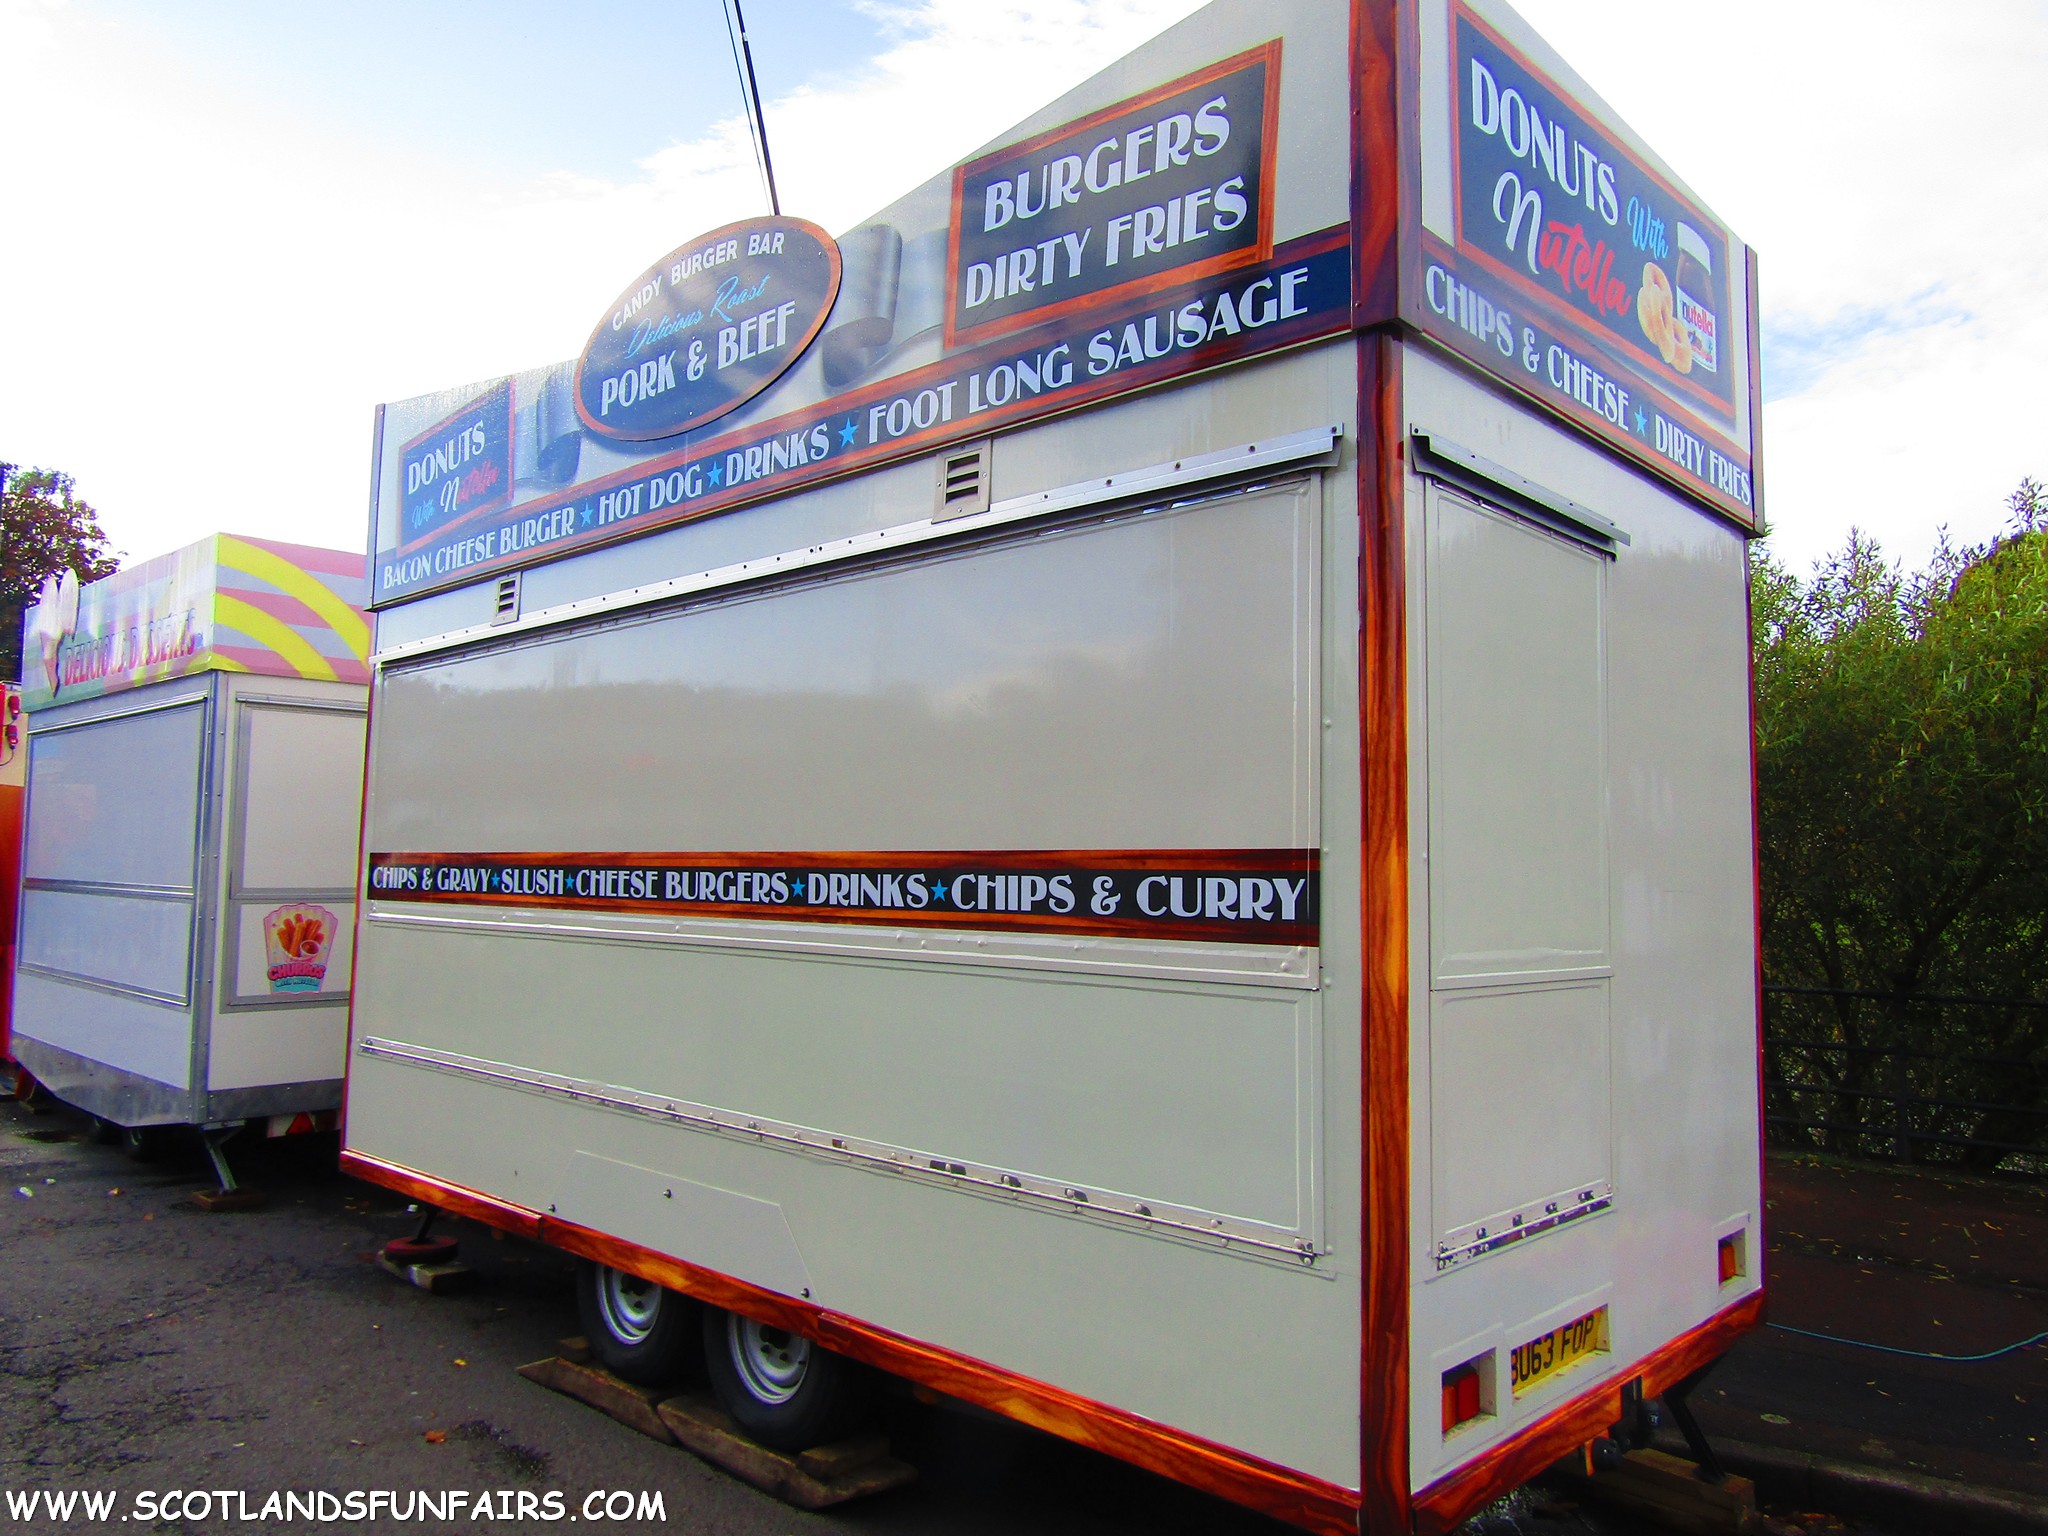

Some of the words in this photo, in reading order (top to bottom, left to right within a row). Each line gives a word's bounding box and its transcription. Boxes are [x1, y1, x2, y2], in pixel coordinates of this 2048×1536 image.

[983, 95, 1231, 233] BURGERS
[1471, 57, 1619, 226] DONUTS
[1626, 195, 1669, 259] With
[612, 275, 663, 331] CANDY
[671, 239, 738, 287] BURGER
[747, 231, 785, 256] BAR
[964, 226, 1092, 309] DIRTY
[1105, 175, 1248, 267] FRIES
[1492, 171, 1632, 317] Nutella
[601, 350, 676, 417] PORK
[686, 340, 708, 382] &
[717, 300, 796, 370] BEEF
[624, 307, 704, 360] Delicious
[710, 273, 770, 323] Roast
[383, 550, 431, 590] BACON
[434, 533, 495, 573] CHEESE
[499, 507, 574, 556] BURGER
[599, 489, 641, 525] HOT
[650, 467, 702, 510] DOG
[725, 423, 830, 487] DRINKS
[868, 380, 958, 445] FOOT
[969, 343, 1074, 414] LONG
[1087, 266, 1309, 377] SAUSAGE
[1425, 264, 1514, 361] CHIPS
[1522, 327, 1541, 373] &
[1547, 343, 1630, 433] CHEESE
[1655, 414, 1705, 479] DIRTY
[1709, 452, 1751, 507] FRIES
[408, 419, 486, 495] DONUTS
[372, 866, 418, 890] CHIPS
[421, 868, 433, 890] &
[437, 869, 491, 893] GRAVY
[500, 868, 565, 896] SLUSH
[575, 870, 658, 899] CHEESE
[665, 871, 790, 904] BURGERS
[807, 872, 930, 908] DRINKS
[951, 874, 1077, 914] CHIPS
[1090, 876, 1121, 916] &
[1136, 876, 1306, 922] CURRY
[1511, 1331, 1555, 1386] BU63
[1561, 1314, 1595, 1361] FOP
